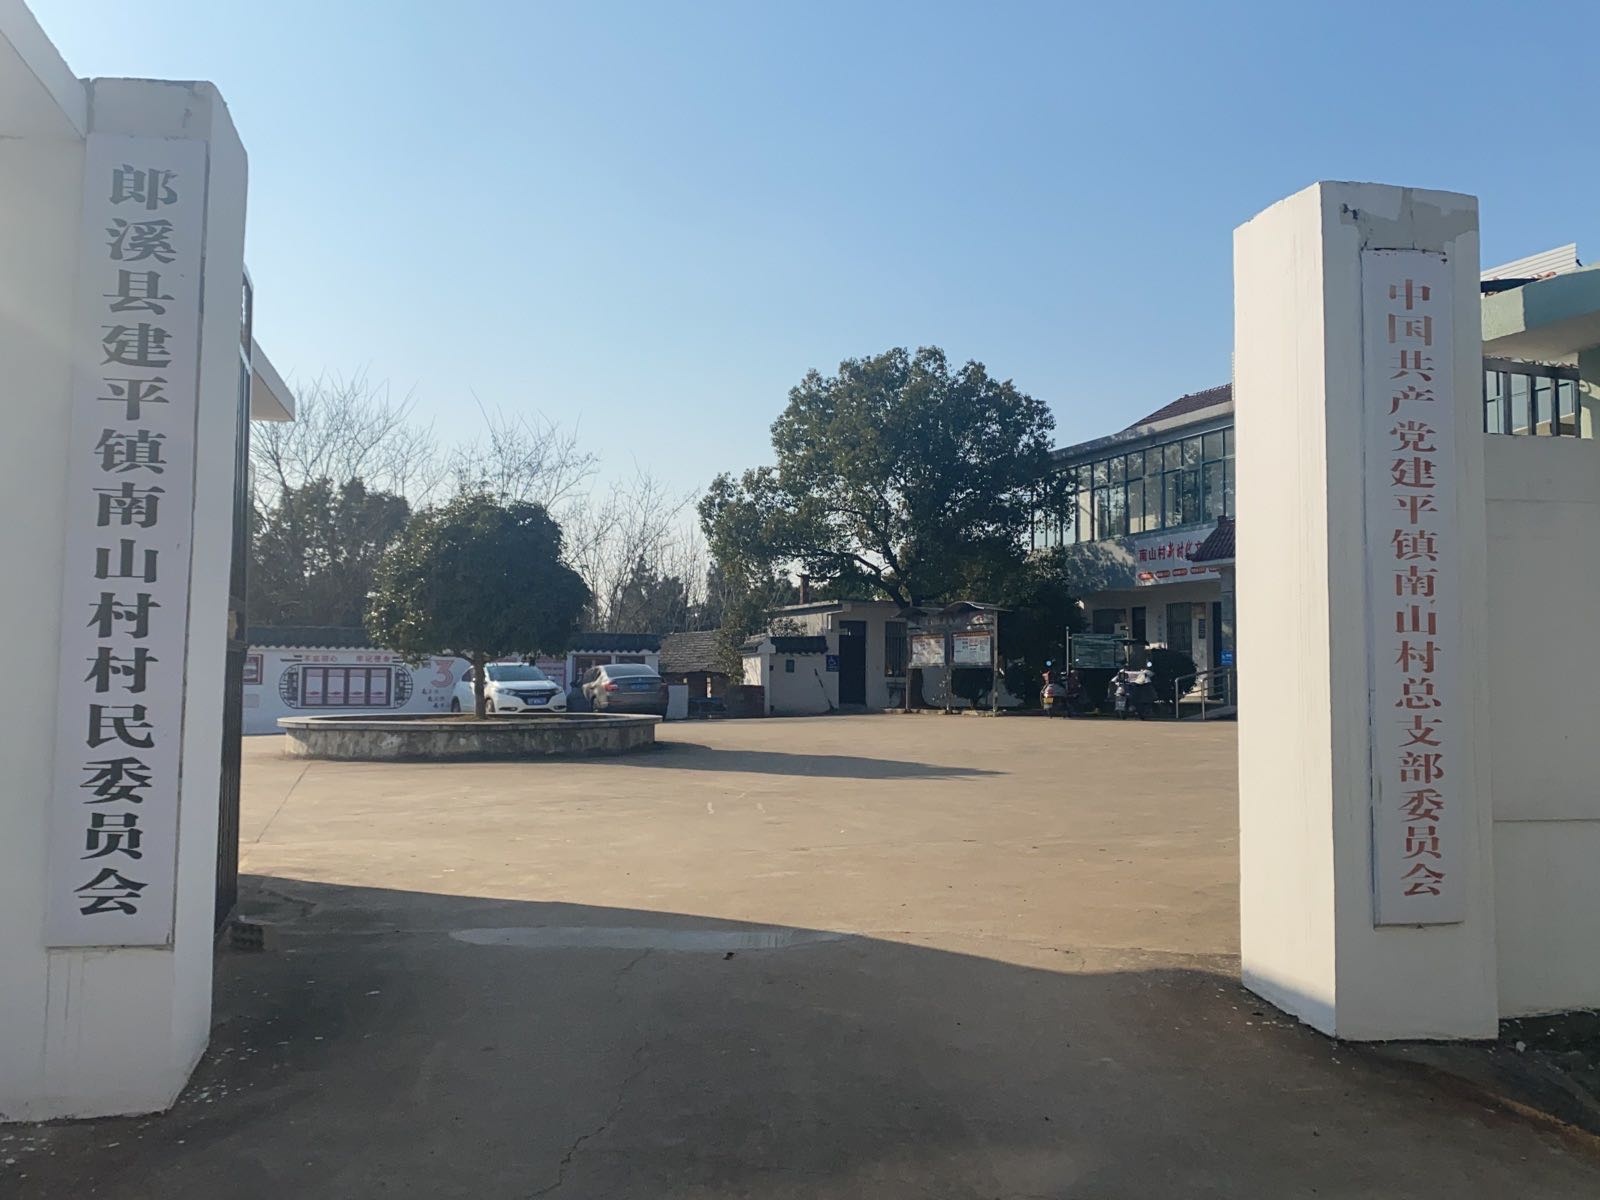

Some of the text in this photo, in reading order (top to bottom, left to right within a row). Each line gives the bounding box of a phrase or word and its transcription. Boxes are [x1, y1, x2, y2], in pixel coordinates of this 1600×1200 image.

[73, 163, 178, 917] 郎溪县建平镇南山村村民委员会
[1387, 279, 1446, 897] 中国共产党建平镇南山村总支部委员会
